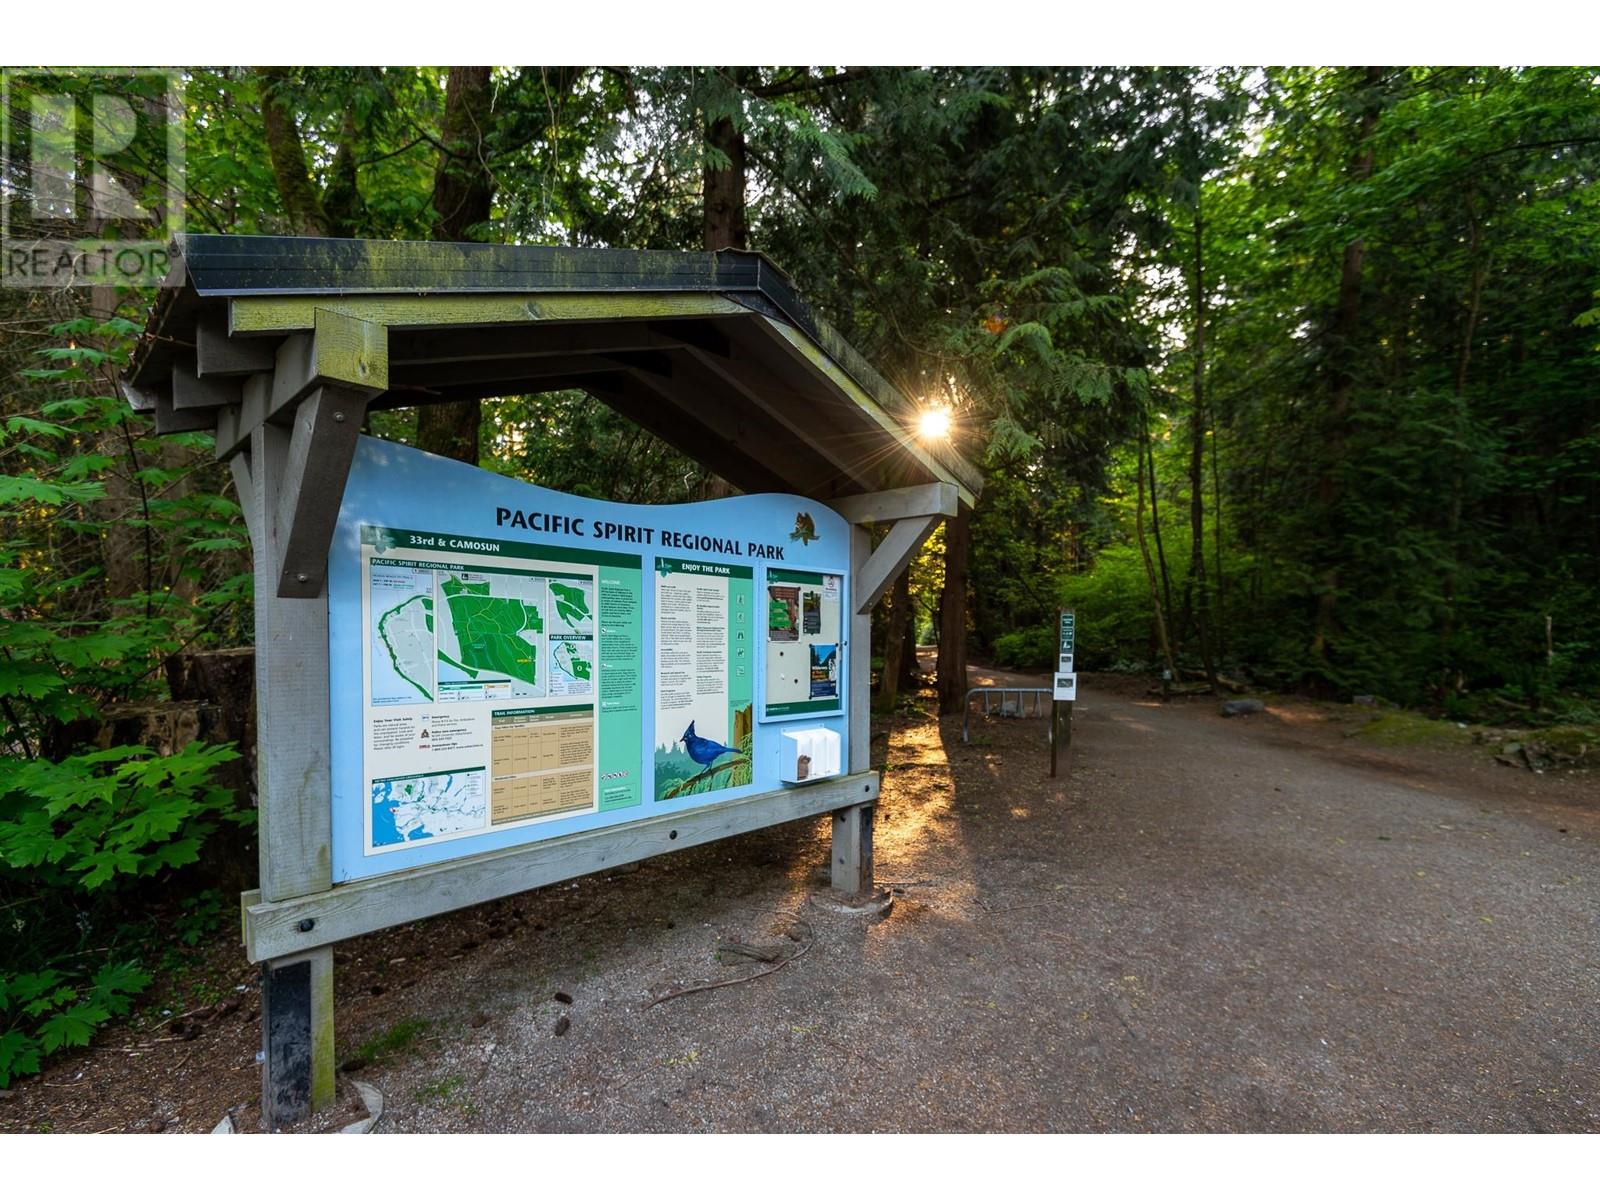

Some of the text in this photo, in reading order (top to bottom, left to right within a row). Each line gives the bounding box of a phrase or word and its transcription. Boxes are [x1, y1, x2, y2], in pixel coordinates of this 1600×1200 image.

[496, 507, 785, 561] PACIFIC SPIRIT REGIONAL PARK
[409, 535, 500, 552] 33rd & CAMOSUN
[372, 558, 397, 566] PACIFIC
[418, 562, 448, 570] REGIONAL
[681, 563, 731, 574] ENJOY THE PARK
